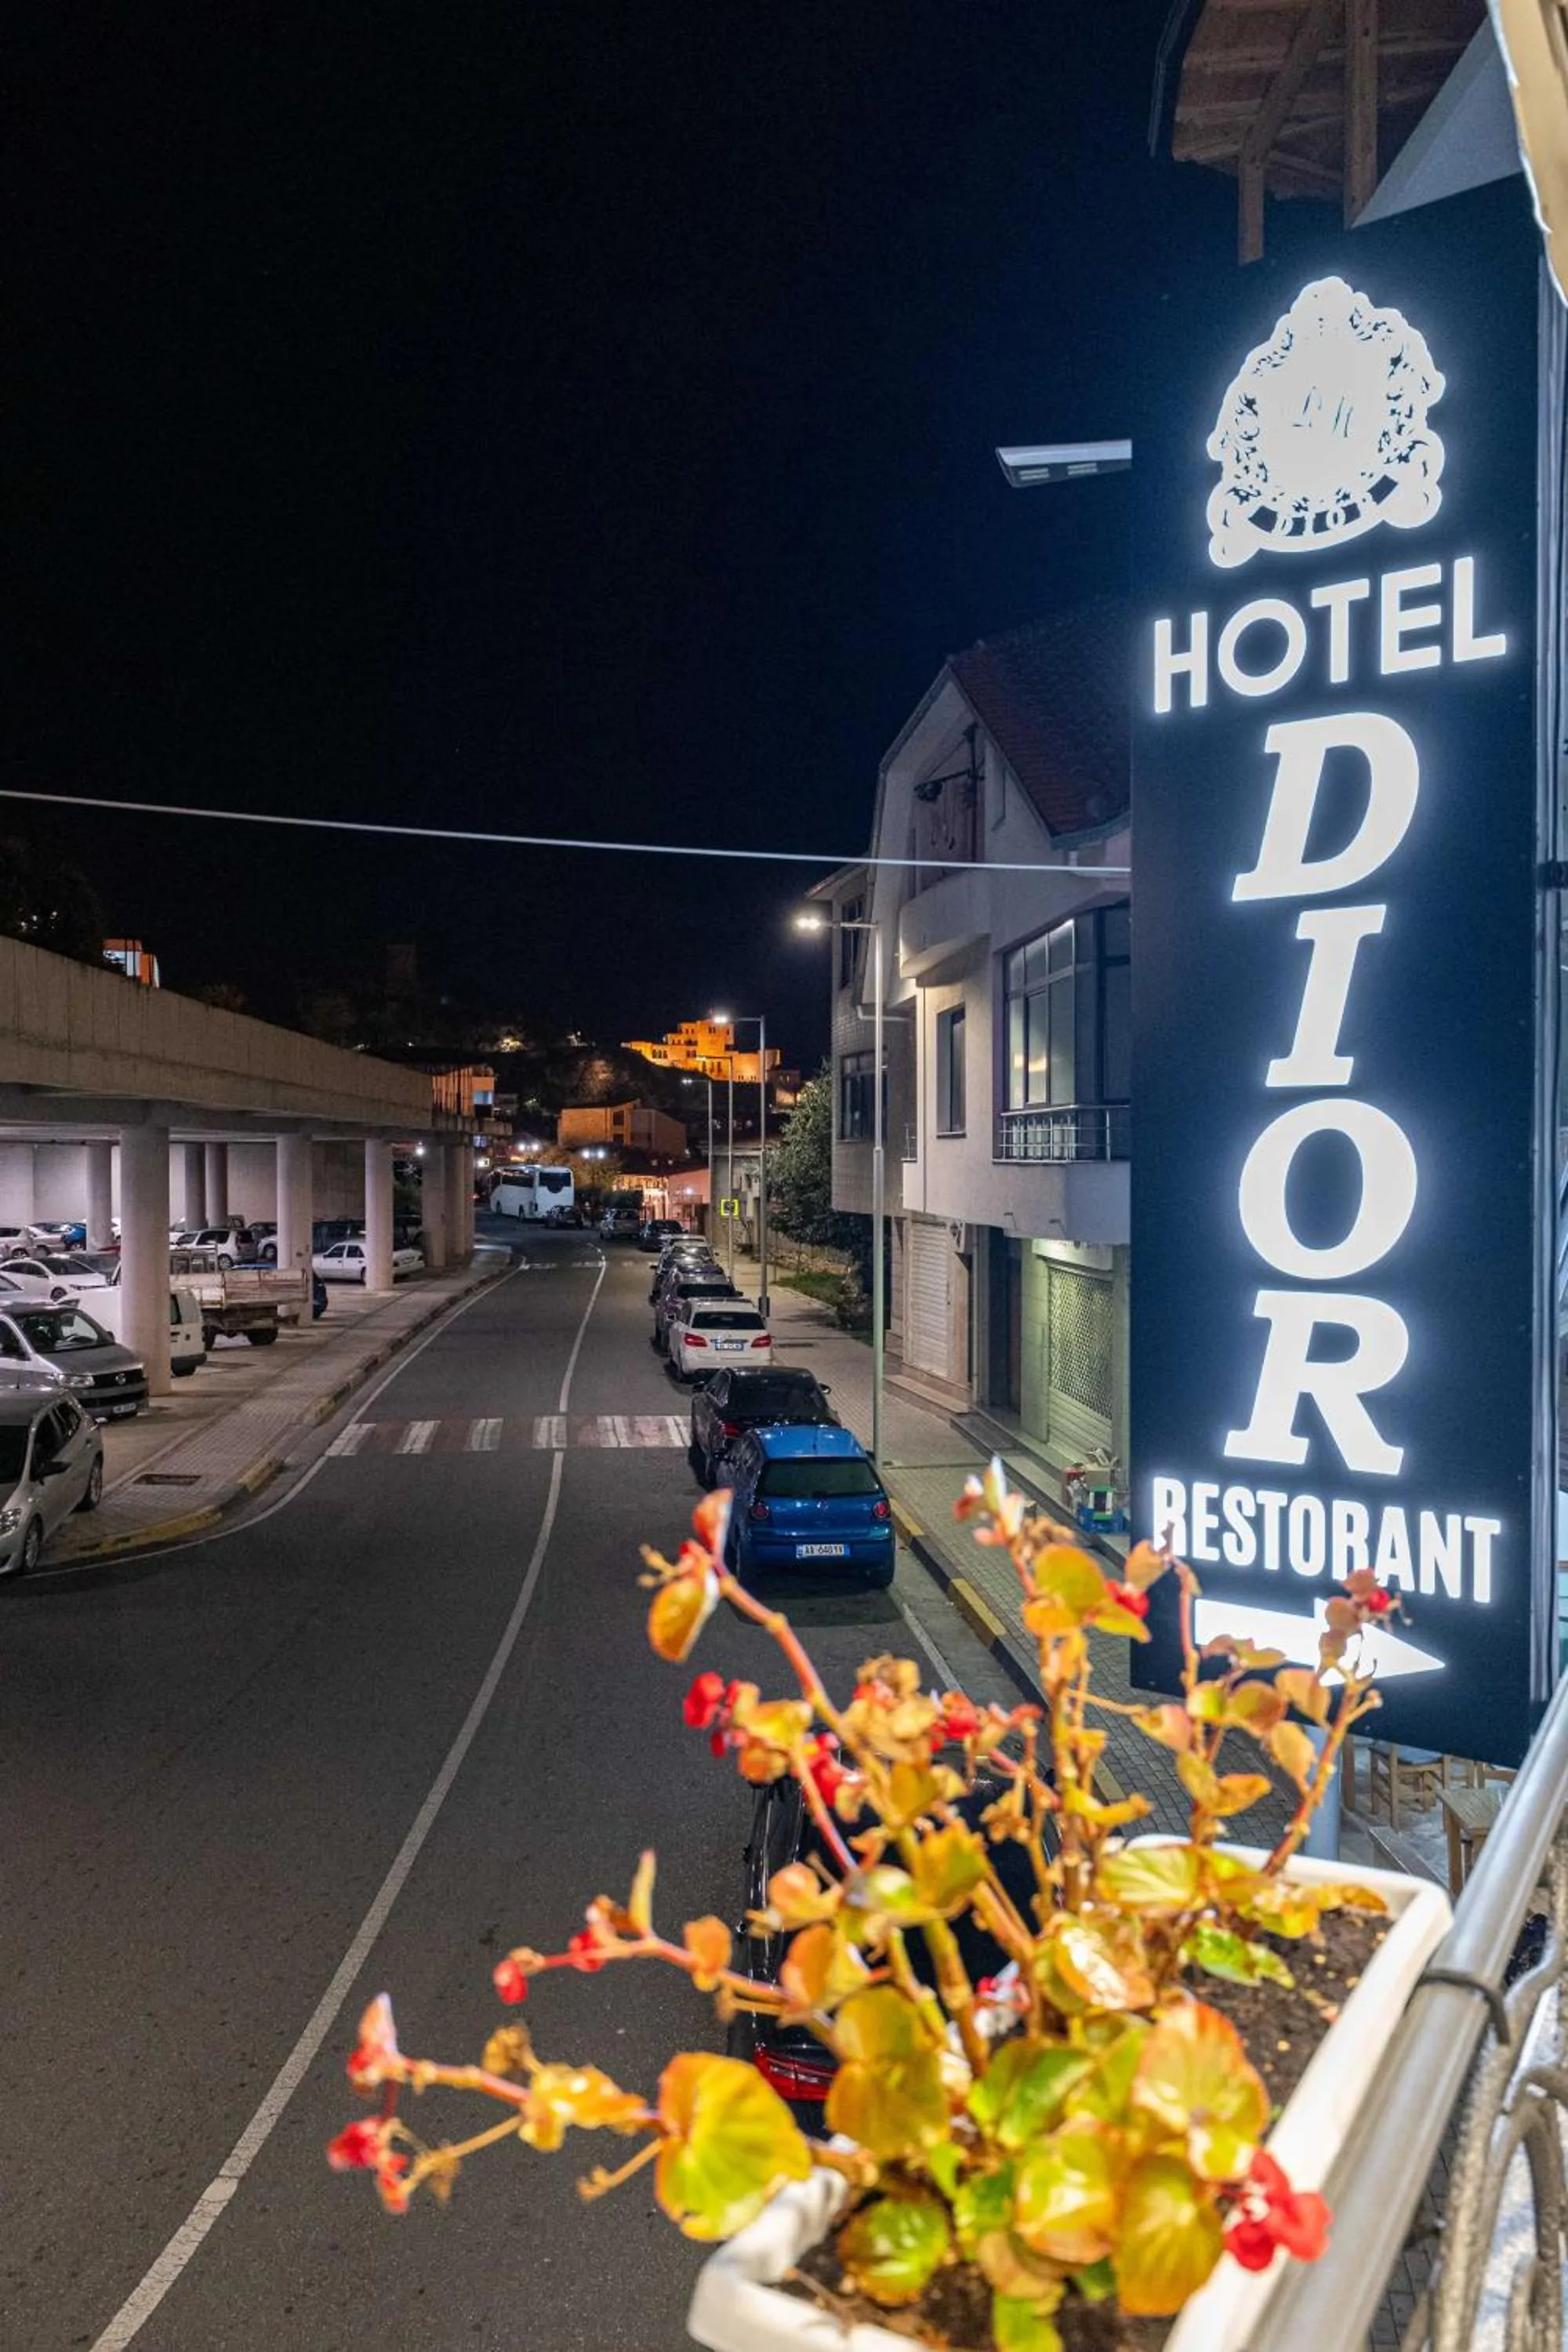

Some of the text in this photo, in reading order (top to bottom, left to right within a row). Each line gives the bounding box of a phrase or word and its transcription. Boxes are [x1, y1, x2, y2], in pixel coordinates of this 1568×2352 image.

[1154, 556, 1507, 714] HOTEL
[1223, 712, 1420, 1476] DIOR
[1152, 1476, 1501, 1604] RESTORANT
